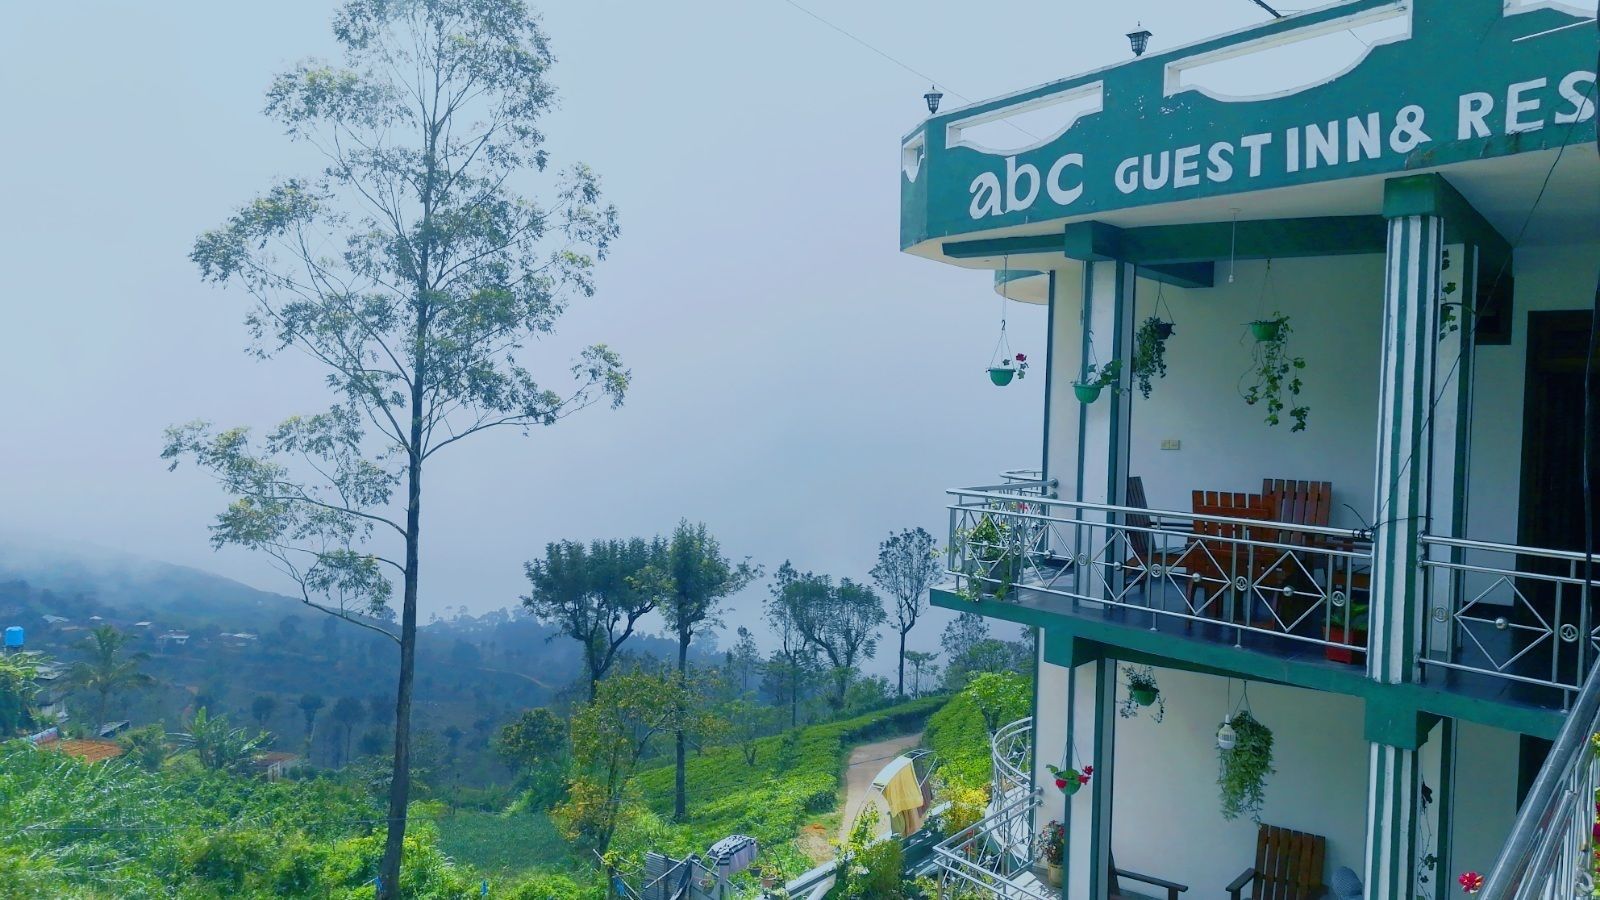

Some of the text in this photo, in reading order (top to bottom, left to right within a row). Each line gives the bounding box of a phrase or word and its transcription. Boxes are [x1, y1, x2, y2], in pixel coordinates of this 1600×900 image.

[969, 153, 1083, 220] abc
[1114, 132, 1272, 194] GUEST
[1457, 70, 1597, 140] RES
